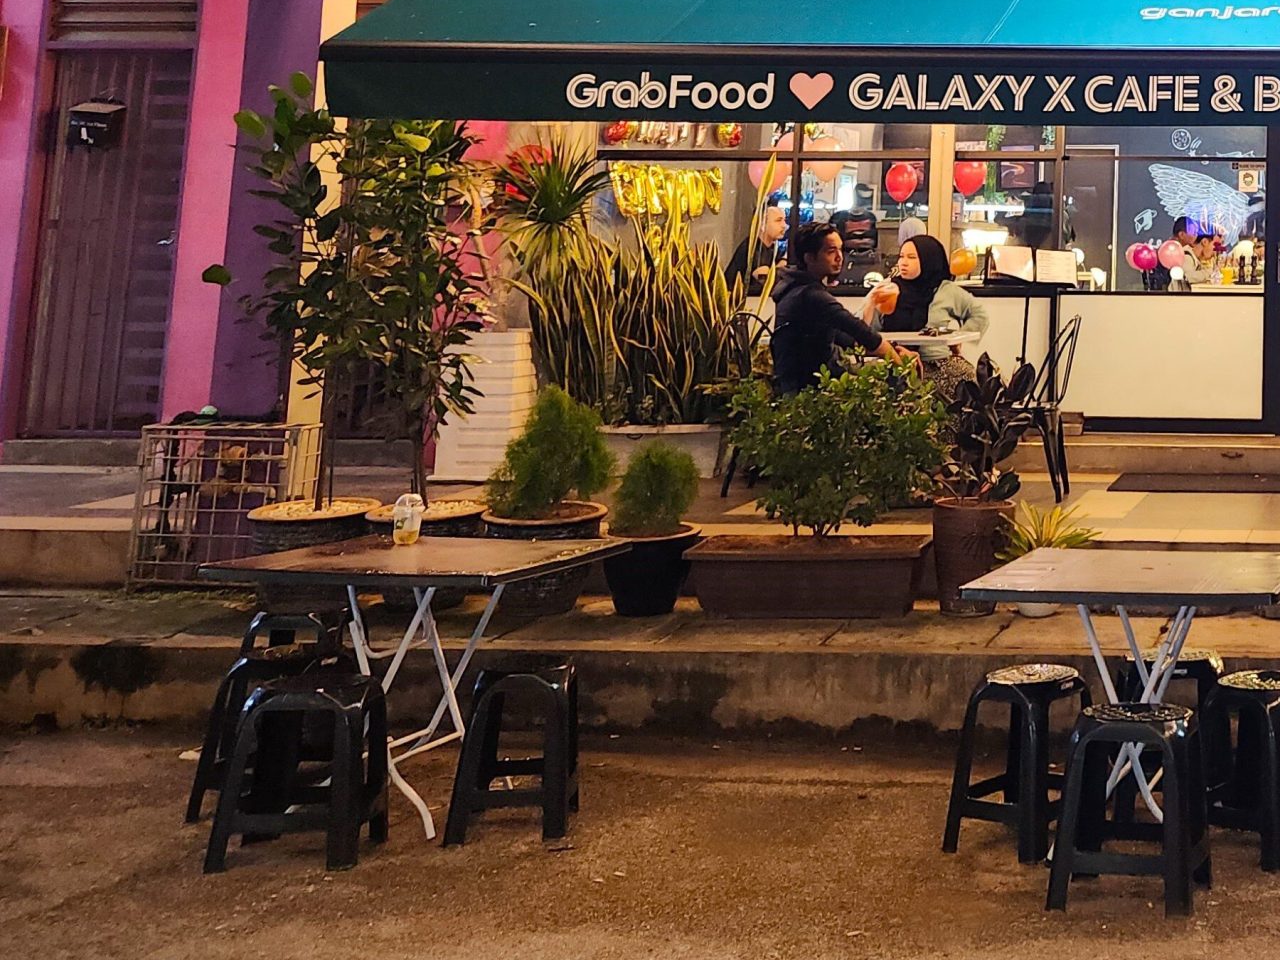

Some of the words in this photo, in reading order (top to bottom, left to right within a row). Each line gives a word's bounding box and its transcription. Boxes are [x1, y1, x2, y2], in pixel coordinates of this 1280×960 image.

[566, 71, 775, 110] GrabFood
[848, 73, 1036, 111] GALAXY
[1043, 75, 1076, 112] X
[1084, 75, 1200, 113] CAFE
[1210, 75, 1243, 113] &
